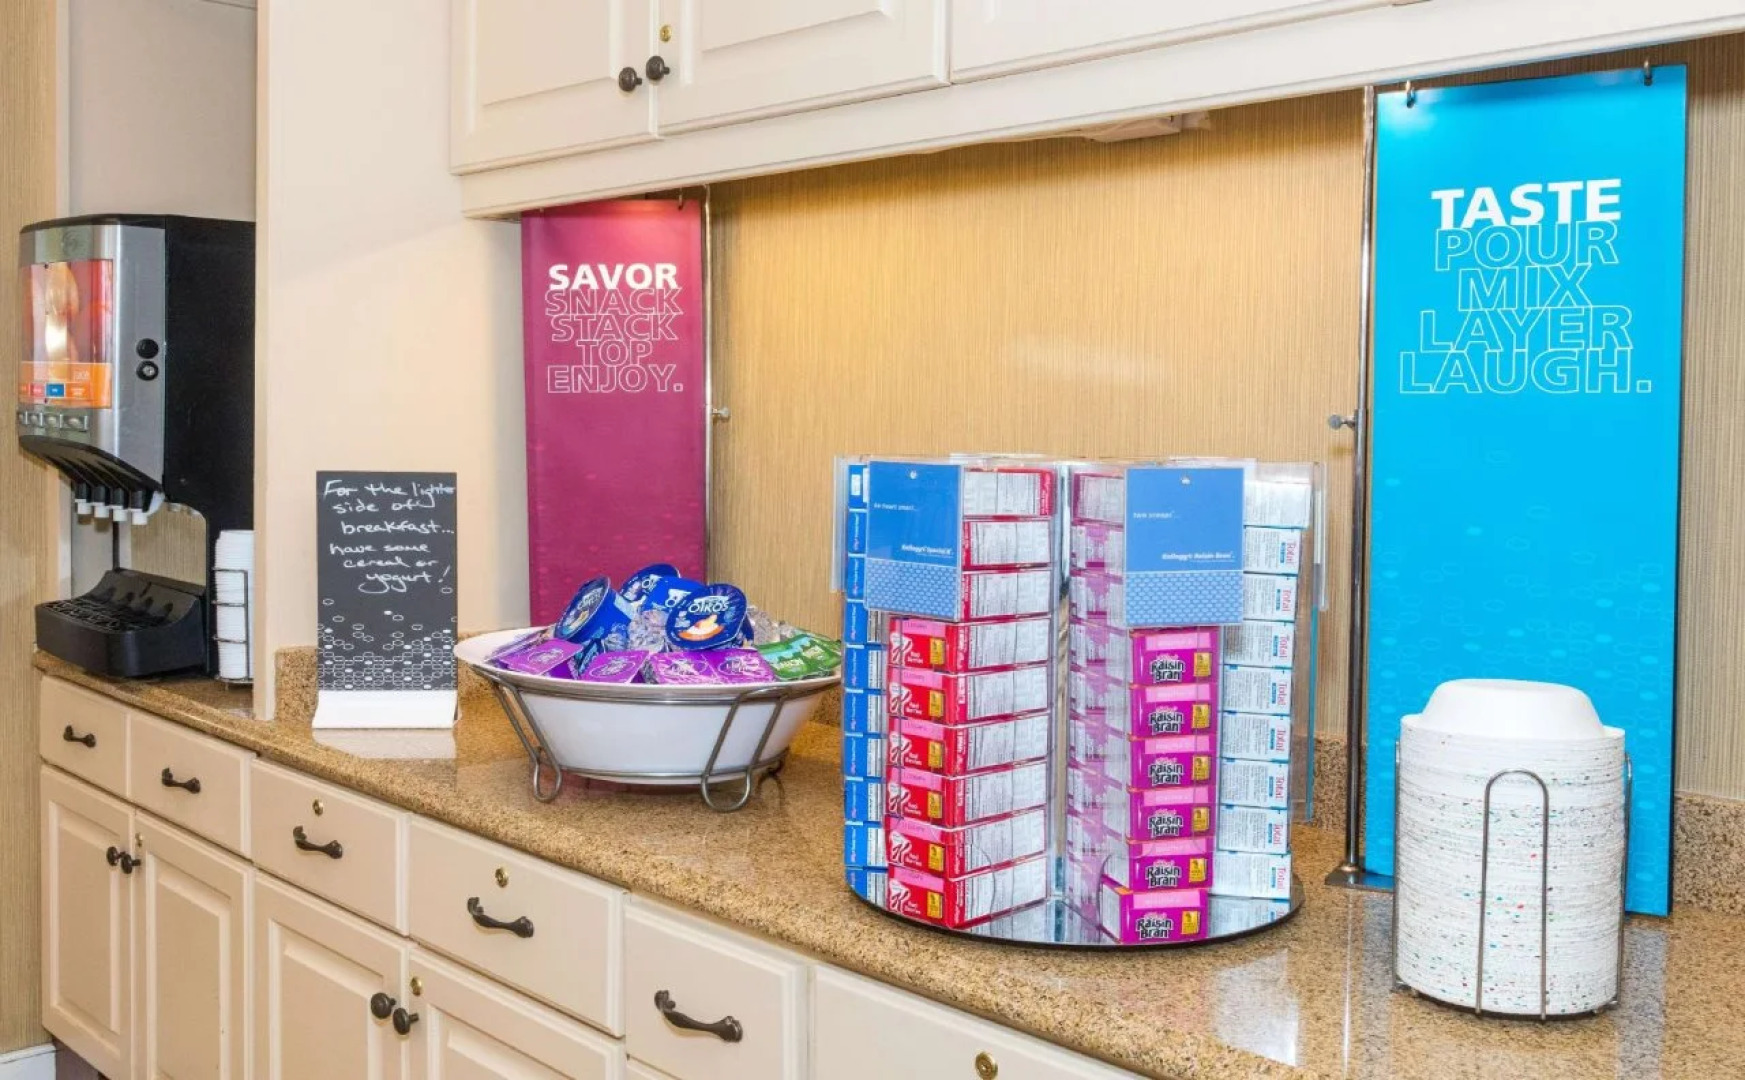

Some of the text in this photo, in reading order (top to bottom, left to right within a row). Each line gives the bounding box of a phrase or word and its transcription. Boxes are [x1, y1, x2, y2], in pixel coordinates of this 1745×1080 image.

[1431, 179, 1622, 230] TASTE
[1435, 220, 1619, 271] POUR
[549, 263, 678, 290] SAVOR
[1458, 262, 1592, 311] MIX
[544, 288, 684, 315] SNACK
[551, 314, 679, 341] STACK
[1420, 305, 1633, 352] LAYER
[576, 340, 653, 367] TOP
[1400, 348, 1652, 394] LAUGH.
[548, 364, 684, 393] ENJOY.
[324, 479, 358, 499] For
[364, 482, 408, 496] the
[333, 498, 415, 514] side of
[341, 520, 454, 535] breakfast...
[330, 543, 430, 555] have some
[343, 556, 411, 568] cereal
[1151, 660, 1184, 672] Raisin
[1154, 670, 1181, 681] Bran
[1150, 712, 1183, 723] Raisin
[1152, 722, 1180, 733] Bran
[1150, 764, 1183, 775] Raisin
[1152, 774, 1180, 785] Bran
[1149, 816, 1183, 827] Raisin
[1152, 825, 1179, 836] Bran
[1147, 866, 1181, 877] Raisin
[1149, 876, 1177, 887] Bran
[1137, 919, 1172, 929] Raisin
[1140, 928, 1168, 939] Bran
